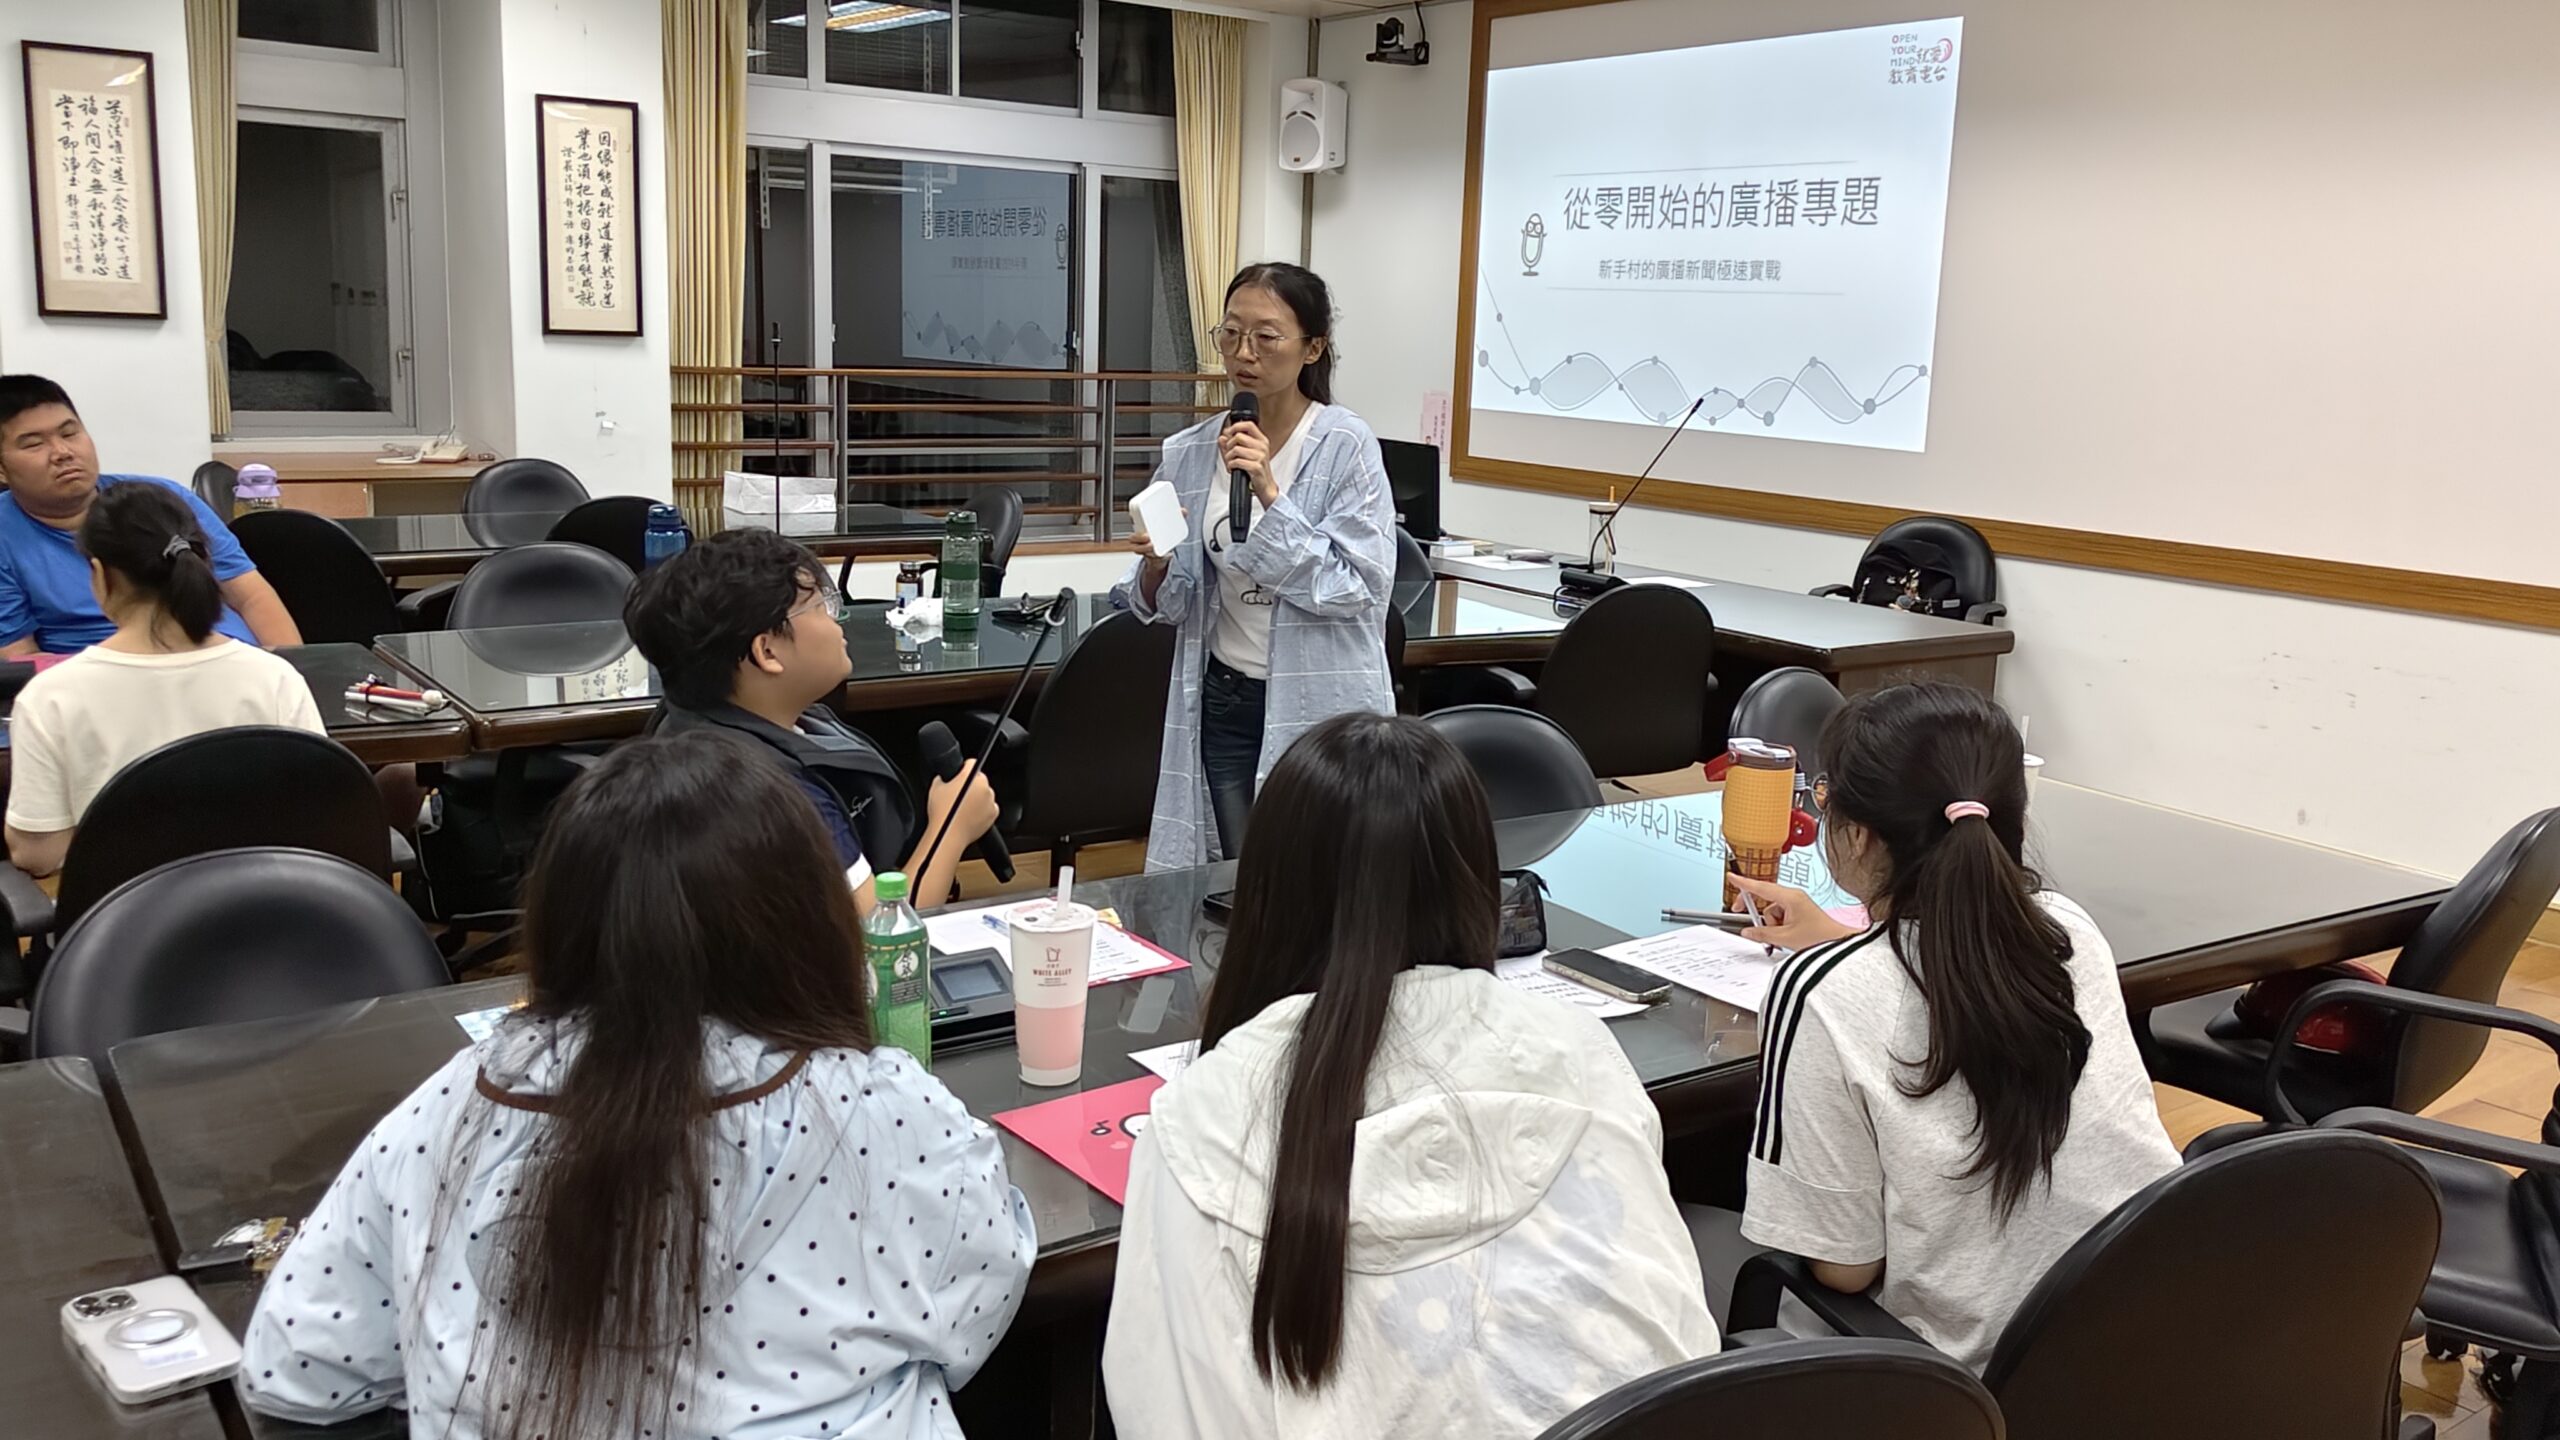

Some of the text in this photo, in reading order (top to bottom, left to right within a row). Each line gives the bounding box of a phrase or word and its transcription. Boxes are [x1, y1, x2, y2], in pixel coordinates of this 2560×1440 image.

[1892, 33, 1918, 44] OPEN
[1891, 45, 1917, 55] YOUR
[1890, 57, 1915, 67] MIND
[1888, 64, 1947, 85] 教育電台
[1563, 176, 1882, 231] 從零開始的廣播專題
[1598, 258, 1782, 283] 新手村的廣播新聞極速實戰
